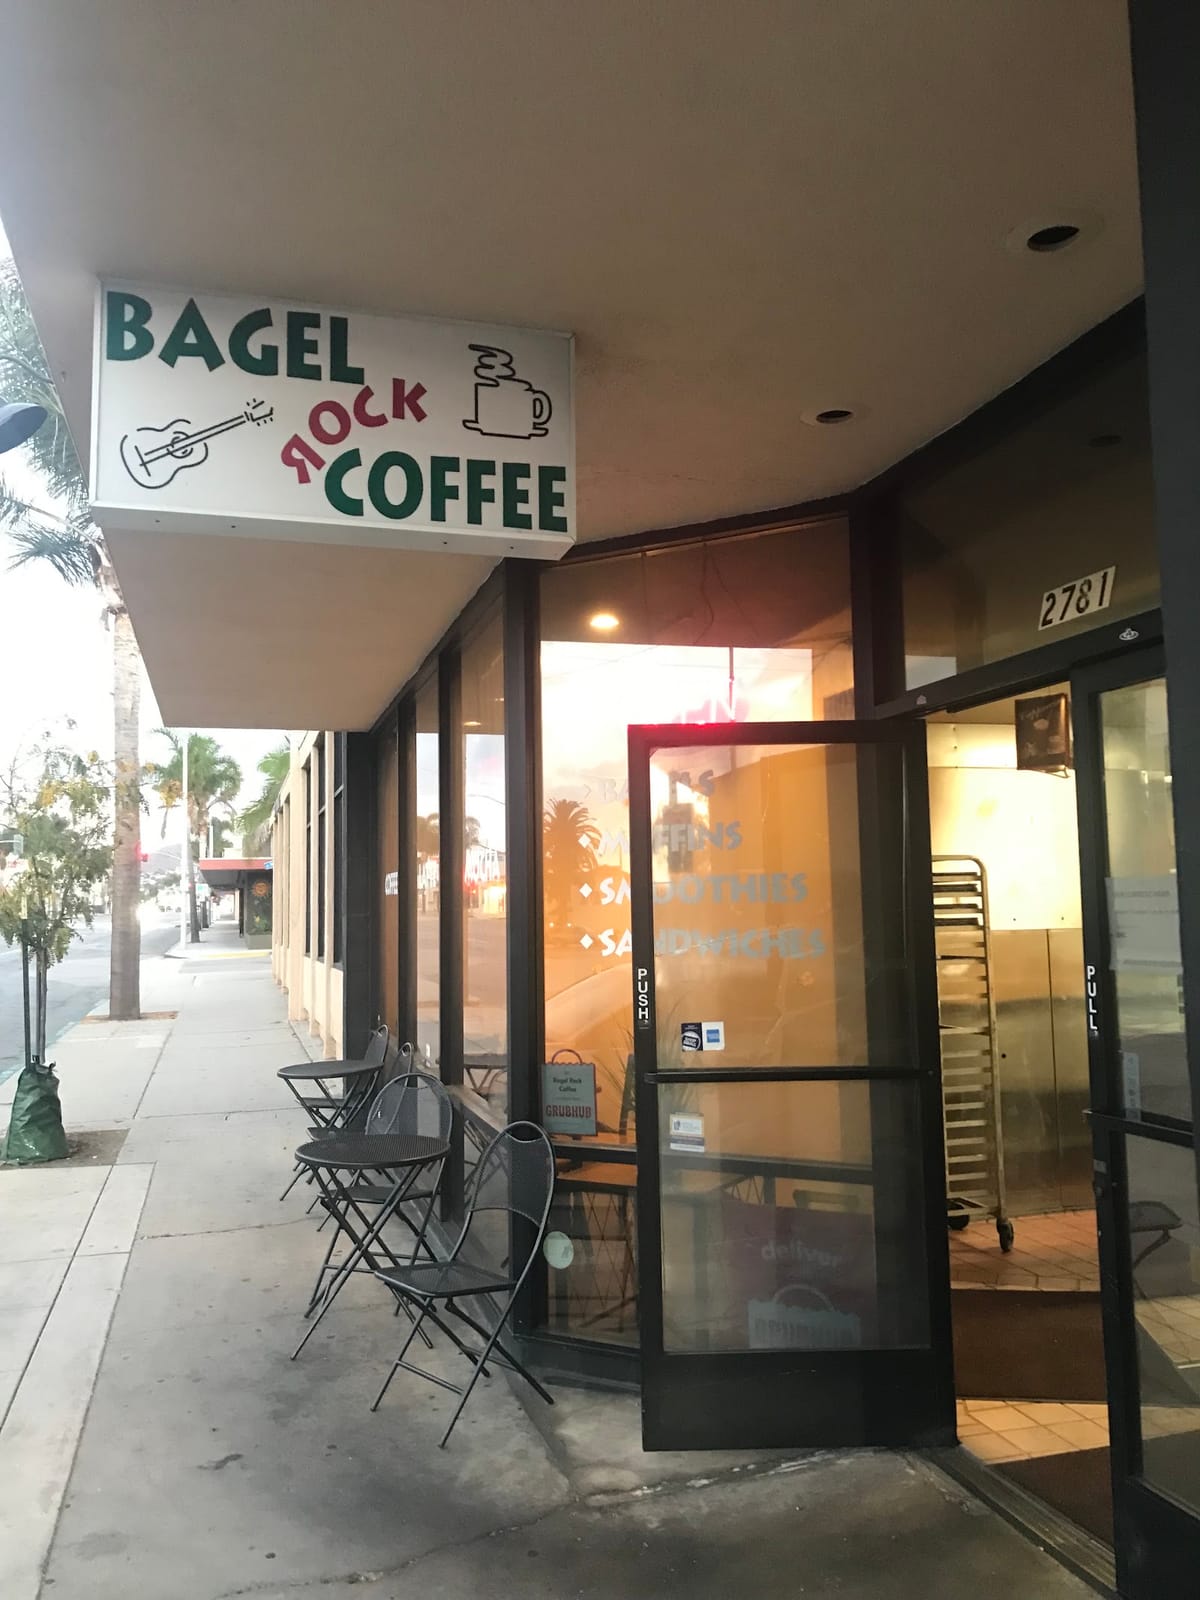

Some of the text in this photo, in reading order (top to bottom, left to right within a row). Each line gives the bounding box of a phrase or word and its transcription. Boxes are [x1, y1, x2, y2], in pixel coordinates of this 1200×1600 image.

[106, 291, 365, 385] BAGEL
[324, 447, 568, 532] COFFEE
[1041, 572, 1108, 627] 2781
[598, 820, 743, 854] MFFINS
[637, 968, 649, 1020] PUSH
[1087, 965, 1098, 1030] PULL
[545, 1104, 592, 1119] GRUBHUB
